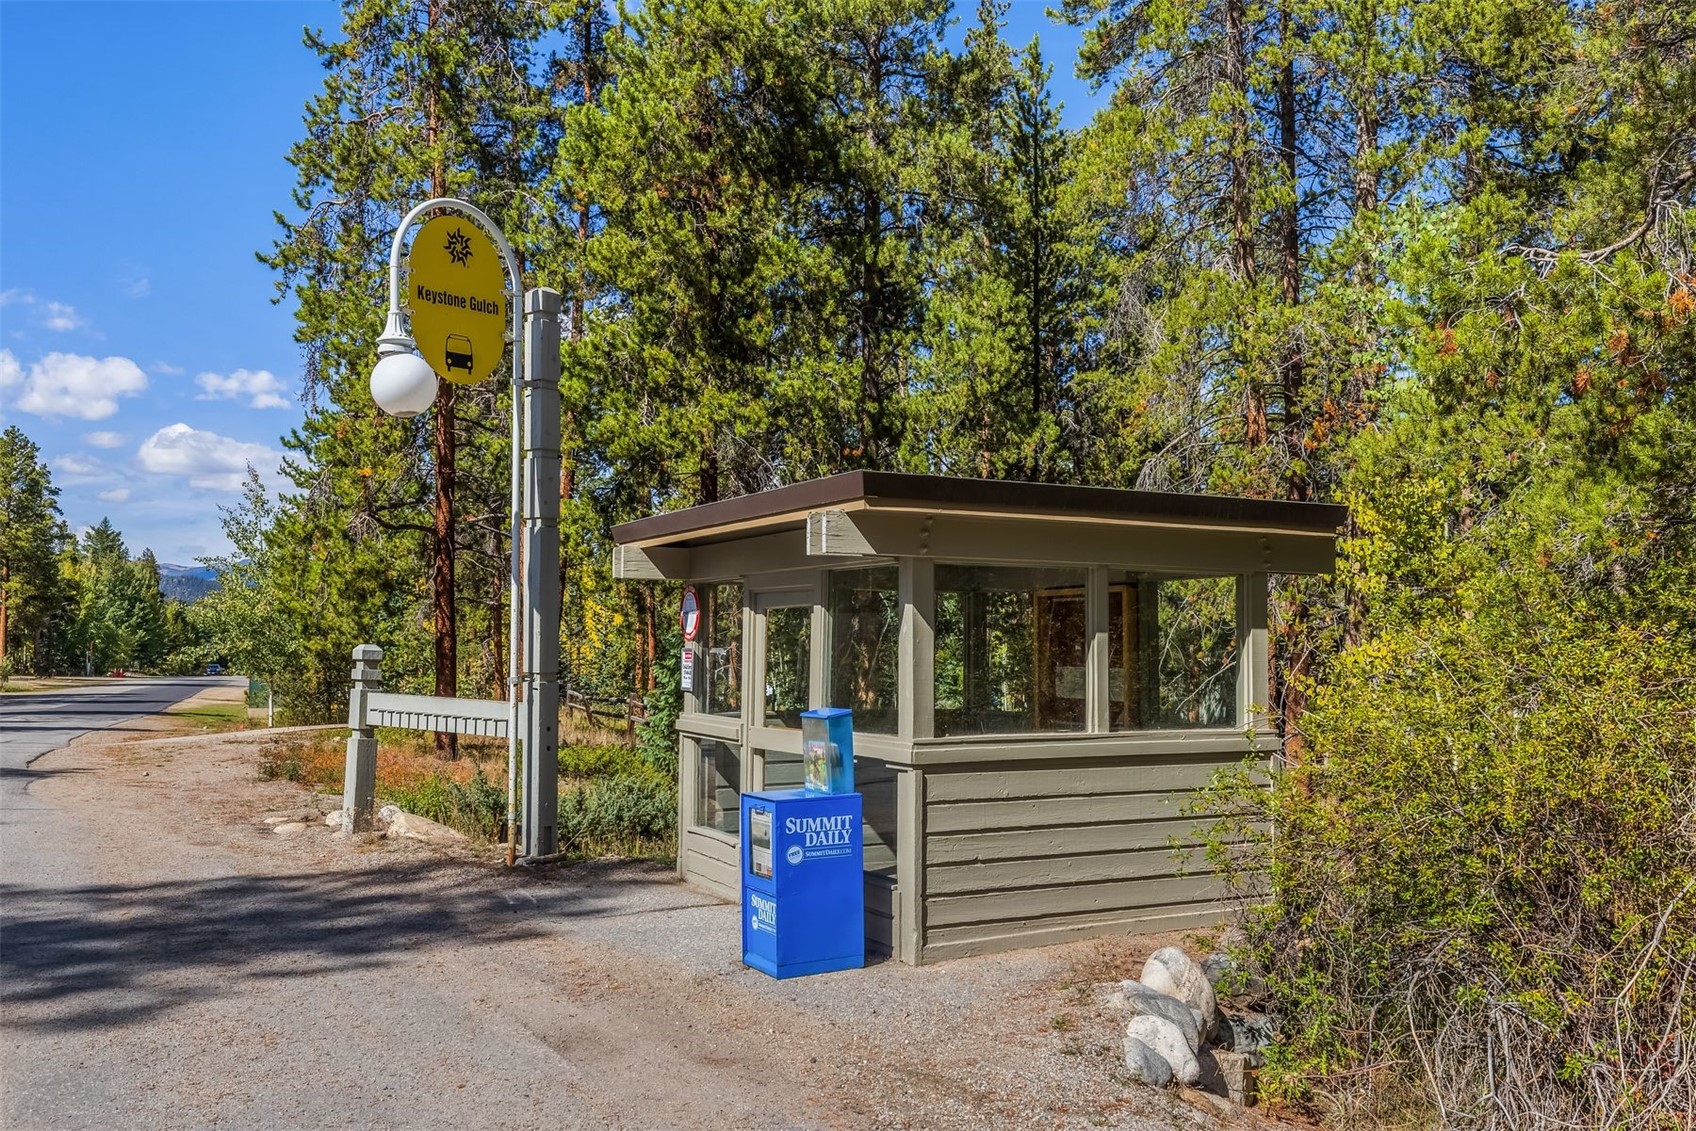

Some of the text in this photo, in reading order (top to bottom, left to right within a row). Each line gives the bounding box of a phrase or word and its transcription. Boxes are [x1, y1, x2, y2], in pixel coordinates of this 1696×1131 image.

[417, 285, 499, 316] Keystone Gulch
[785, 815, 853, 834] SUMMIT
[804, 829, 853, 847] DAILY
[751, 894, 777, 914] SUMMIT
[758, 908, 777, 925] DAILY
